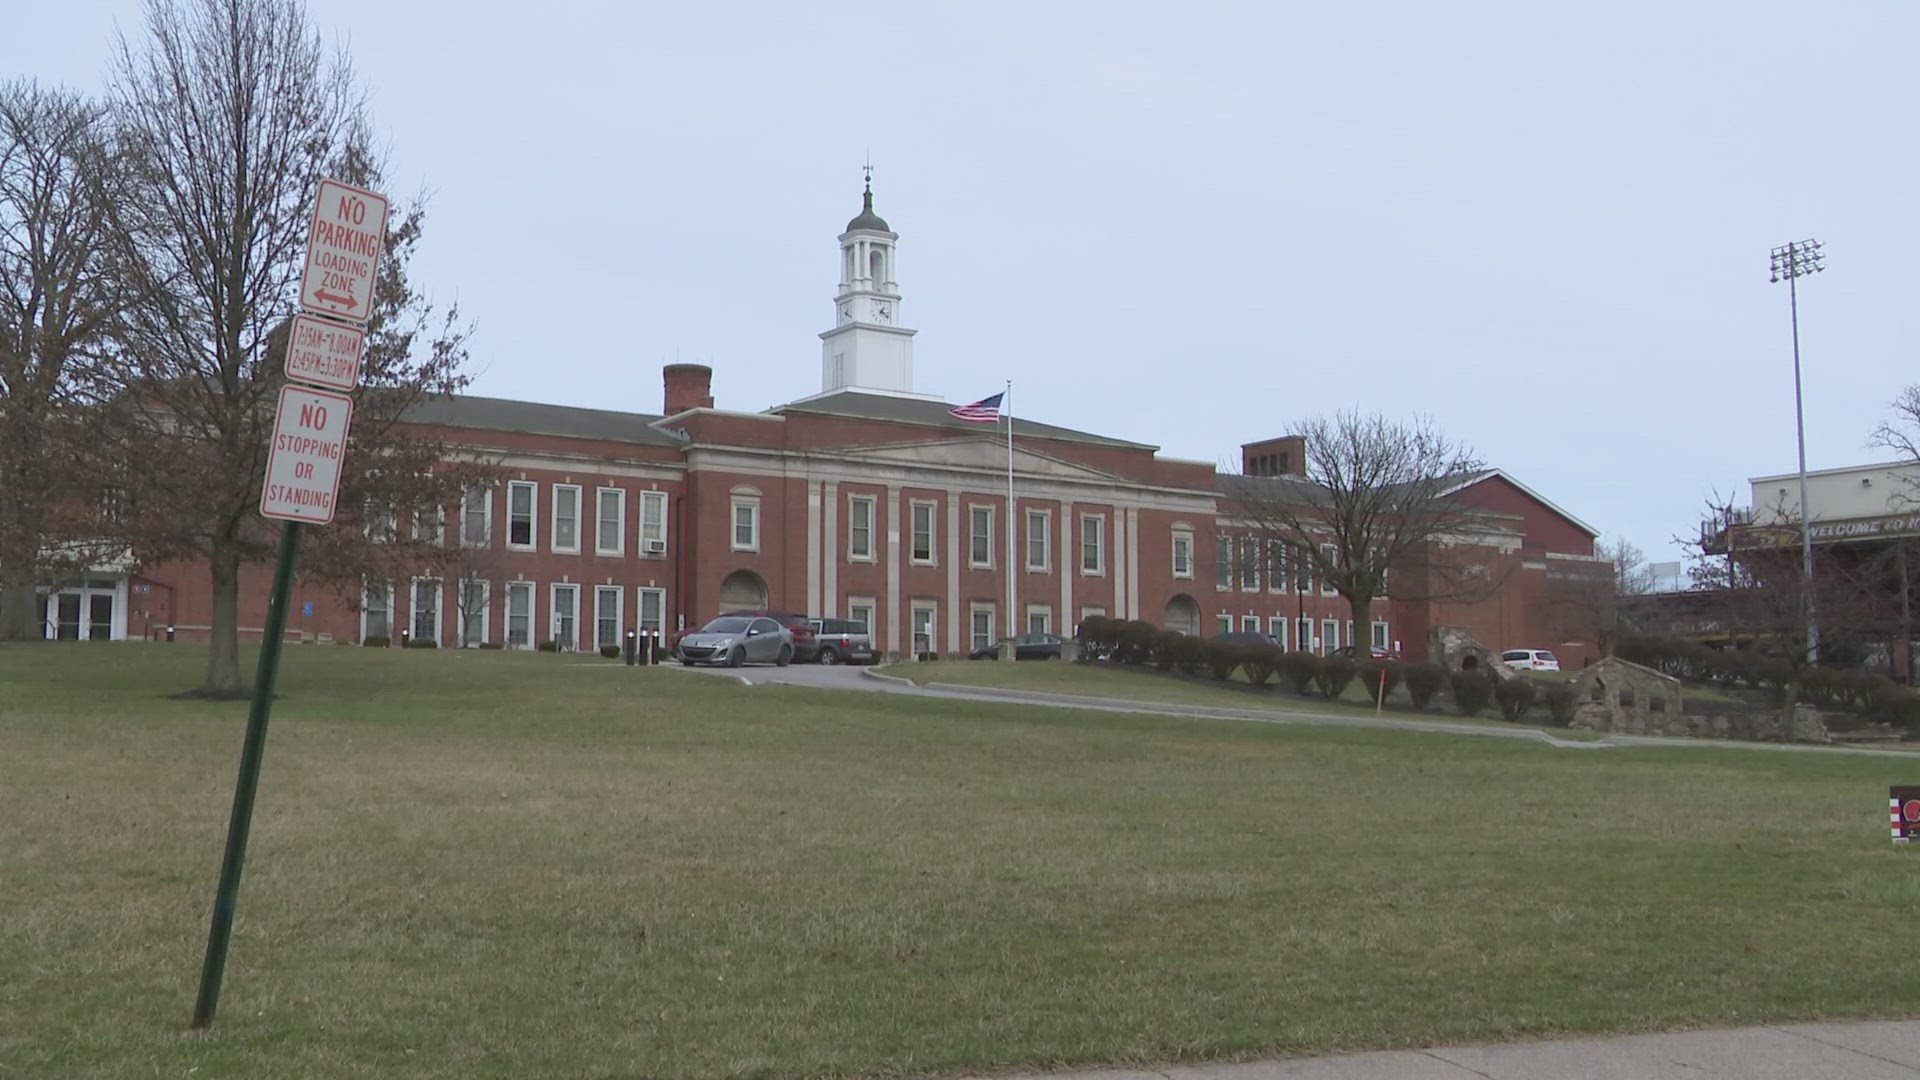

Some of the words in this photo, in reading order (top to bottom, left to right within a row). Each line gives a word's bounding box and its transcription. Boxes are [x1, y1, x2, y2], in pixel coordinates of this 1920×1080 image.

[338, 195, 366, 225] NO
[315, 220, 377, 258] PARKING
[314, 251, 368, 278] LOADING
[321, 270, 356, 294] ZONE
[299, 403, 327, 431] NO
[278, 434, 339, 460] STOPPING
[294, 461, 314, 480] OR
[269, 485, 330, 509] STANDING
